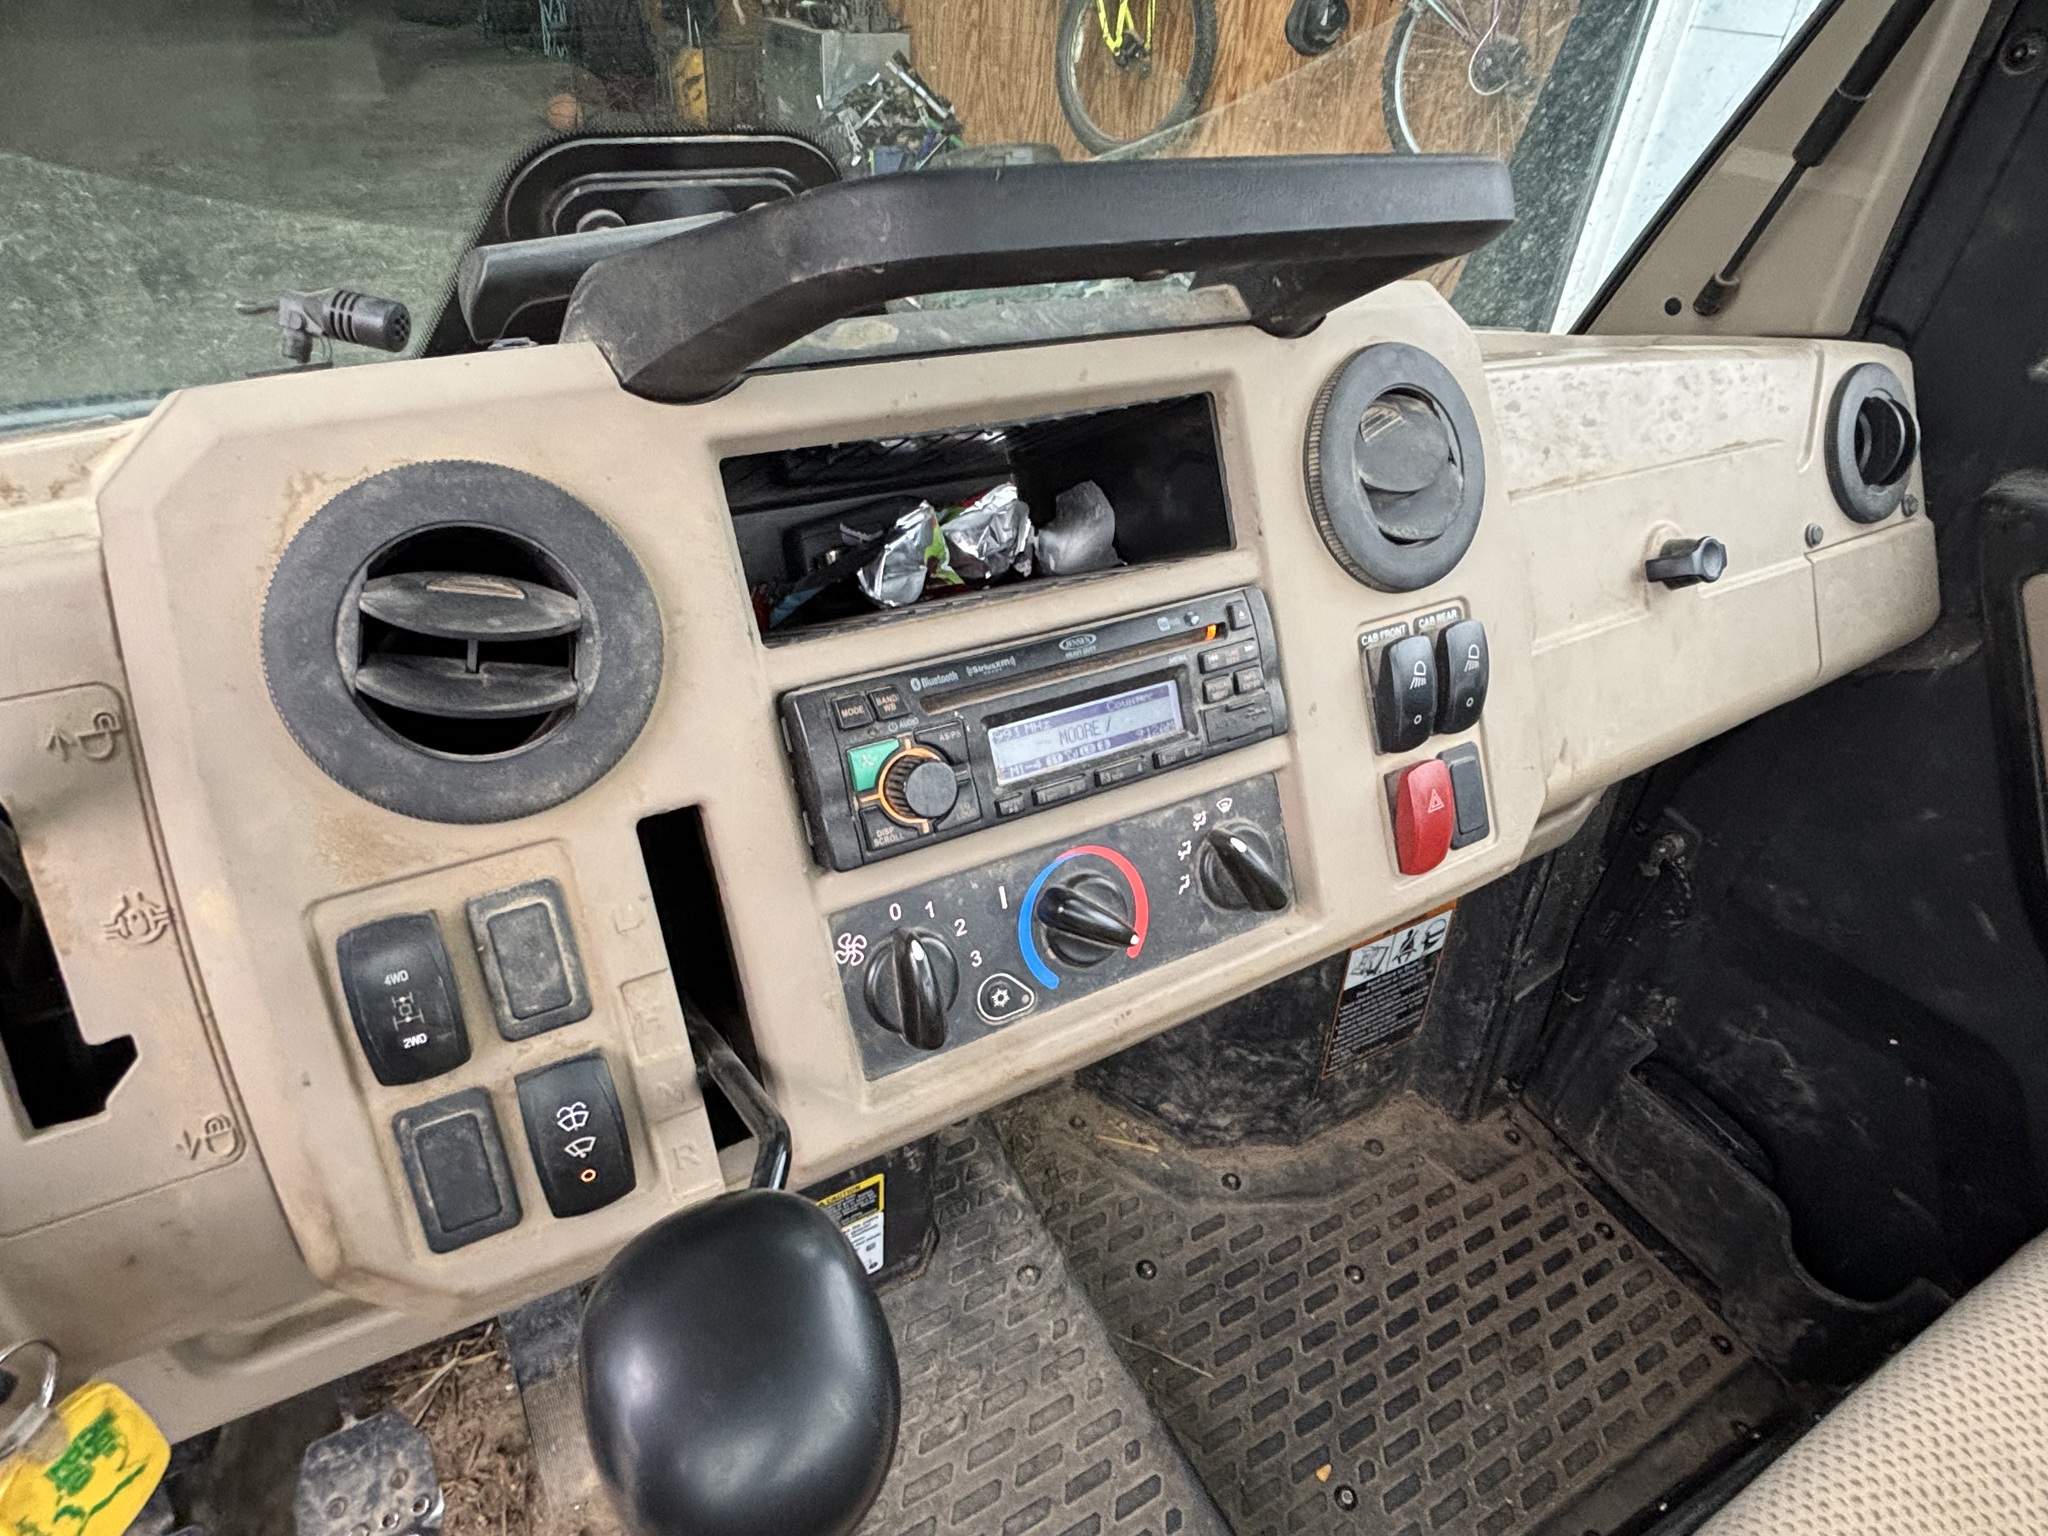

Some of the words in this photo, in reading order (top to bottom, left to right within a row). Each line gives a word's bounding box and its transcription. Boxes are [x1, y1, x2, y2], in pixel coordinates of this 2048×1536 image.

[1418, 616, 1435, 629] CAB
[1435, 609, 1458, 623] REAR
[1361, 634, 1379, 646] CAB
[1379, 624, 1406, 639] FRONT
[921, 671, 959, 688] Bluetooth
[875, 694, 899, 707] BAND
[841, 705, 865, 718] MODE
[1024, 720, 1051, 735] MHz
[1058, 721, 1100, 746] MOORE
[873, 833, 904, 847] SCROLL
[876, 825, 895, 838] DISP
[889, 903, 902, 921] 0
[925, 901, 935, 918] 1
[954, 918, 968, 936] 2
[970, 950, 982, 967] 3
[384, 969, 409, 986] 4WD
[403, 1032, 428, 1049] 2WD
[672, 1144, 702, 1171] R
